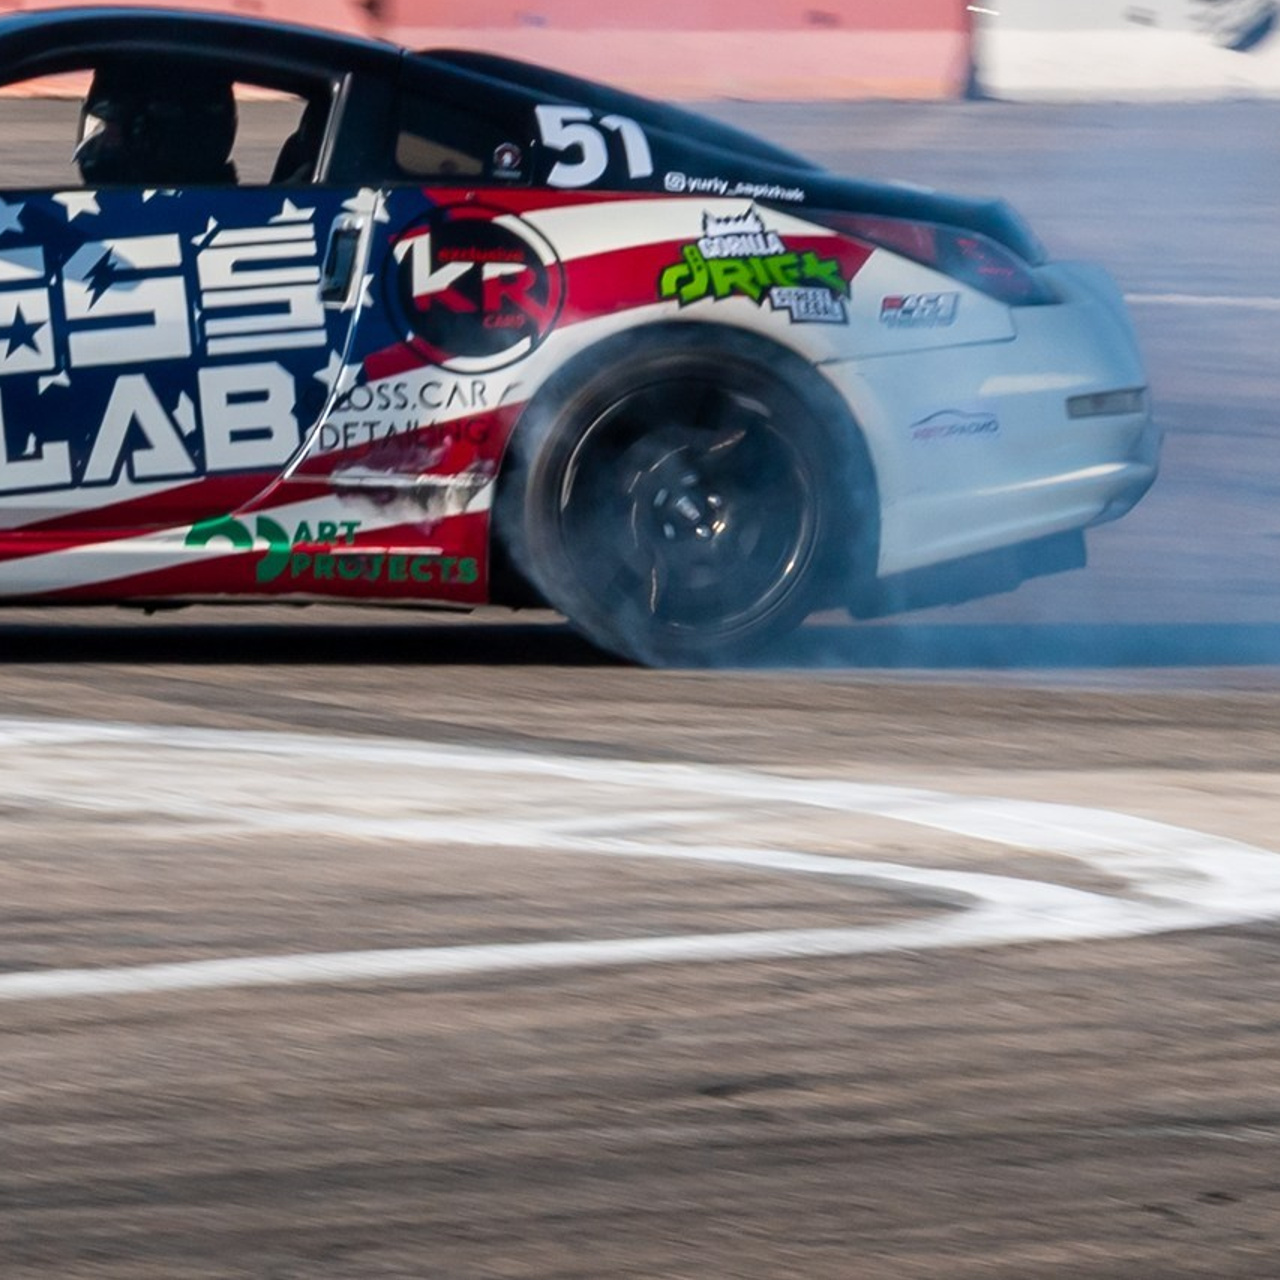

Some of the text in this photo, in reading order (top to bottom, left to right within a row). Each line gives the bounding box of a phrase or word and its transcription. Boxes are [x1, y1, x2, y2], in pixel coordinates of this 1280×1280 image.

[697, 231, 786, 259] GORILLA
[394, 226, 550, 324] KR
[291, 519, 362, 546] ART
[291, 554, 479, 585] PROJECTS
